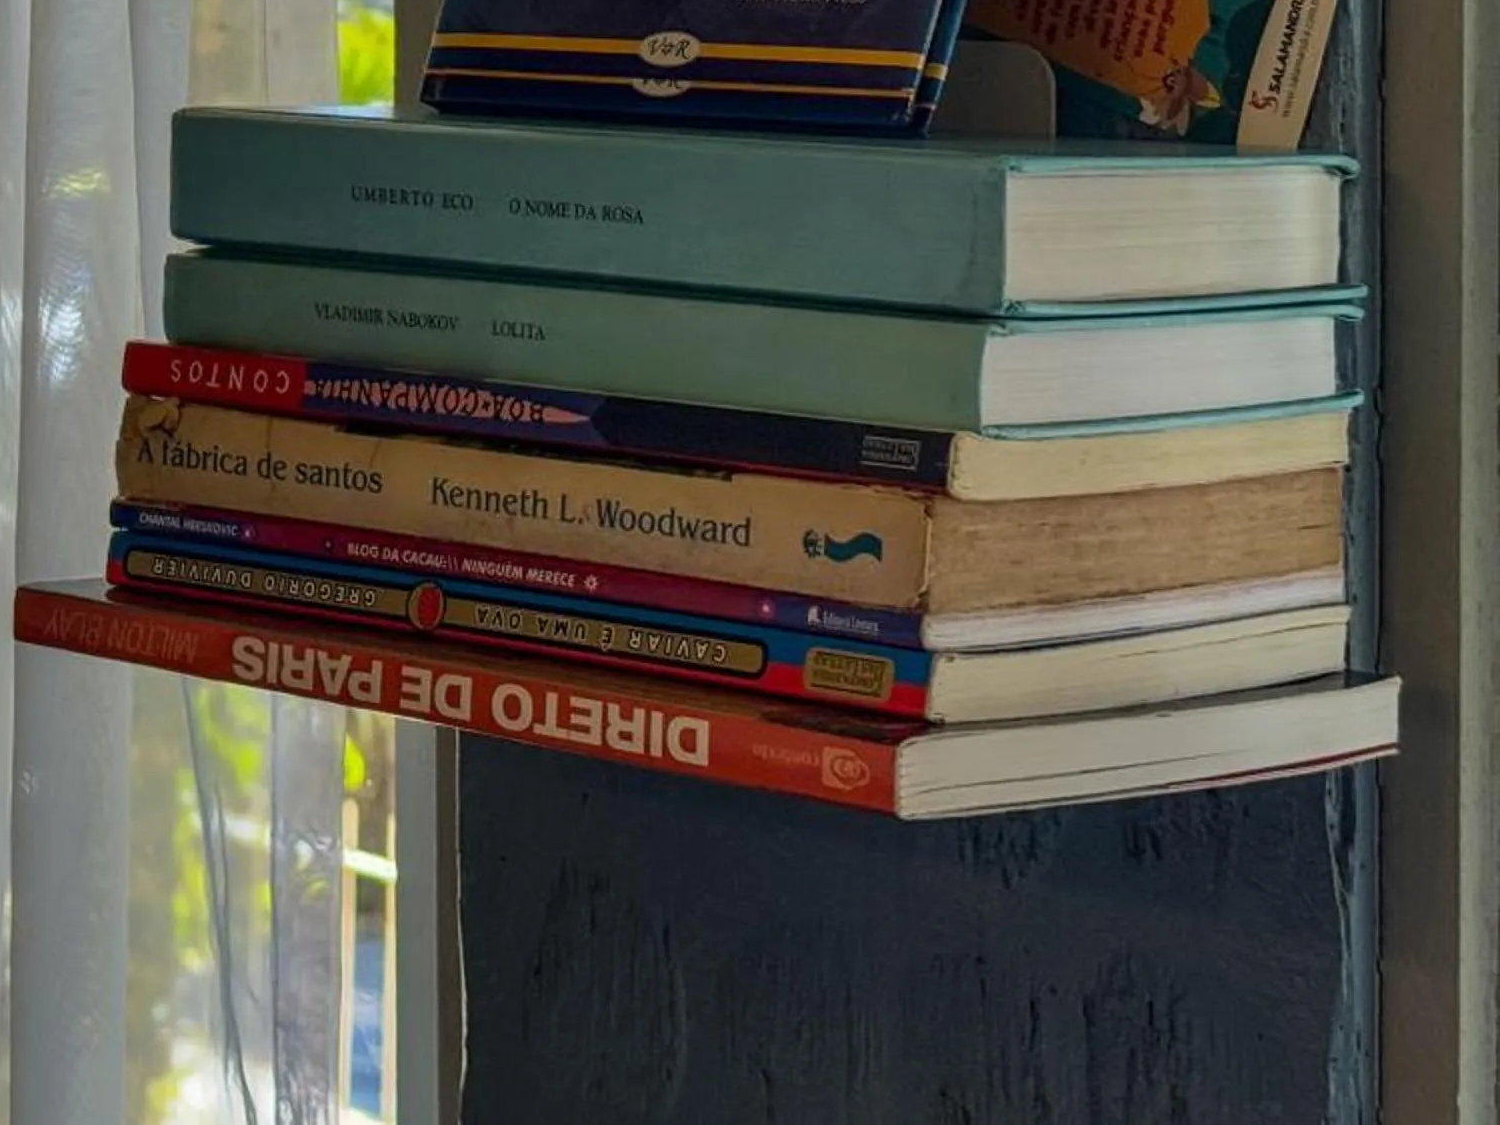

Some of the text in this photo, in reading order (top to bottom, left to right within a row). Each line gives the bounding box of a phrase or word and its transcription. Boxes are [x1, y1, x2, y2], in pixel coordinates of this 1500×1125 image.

[351, 185, 473, 211] UMBERTO ECO
[509, 197, 644, 224] O NOME DA ROSA
[314, 302, 459, 332] VLADIMIR NABOKOV
[491, 319, 546, 341] LOLITA
[169, 358, 291, 396] CONTOS
[315, 378, 481, 418] COMPANHIA
[137, 438, 383, 493] A fábrica de santos
[138, 512, 180, 529] CHANTAL
[431, 477, 751, 548] Kenneth L. Woodward
[153, 557, 377, 607] GREGORIO DUVIVIER
[347, 542, 379, 559] BLOG
[381, 548, 399, 562] DA
[461, 557, 523, 581] NINGUÉM
[525, 568, 576, 589] MERECE
[43, 607, 200, 665] MILTON BLAY
[475, 605, 523, 630] OVA
[534, 617, 588, 642] UMA
[627, 628, 728, 664] CAVIAR
[232, 635, 711, 767] DIRETO DE PARIS
